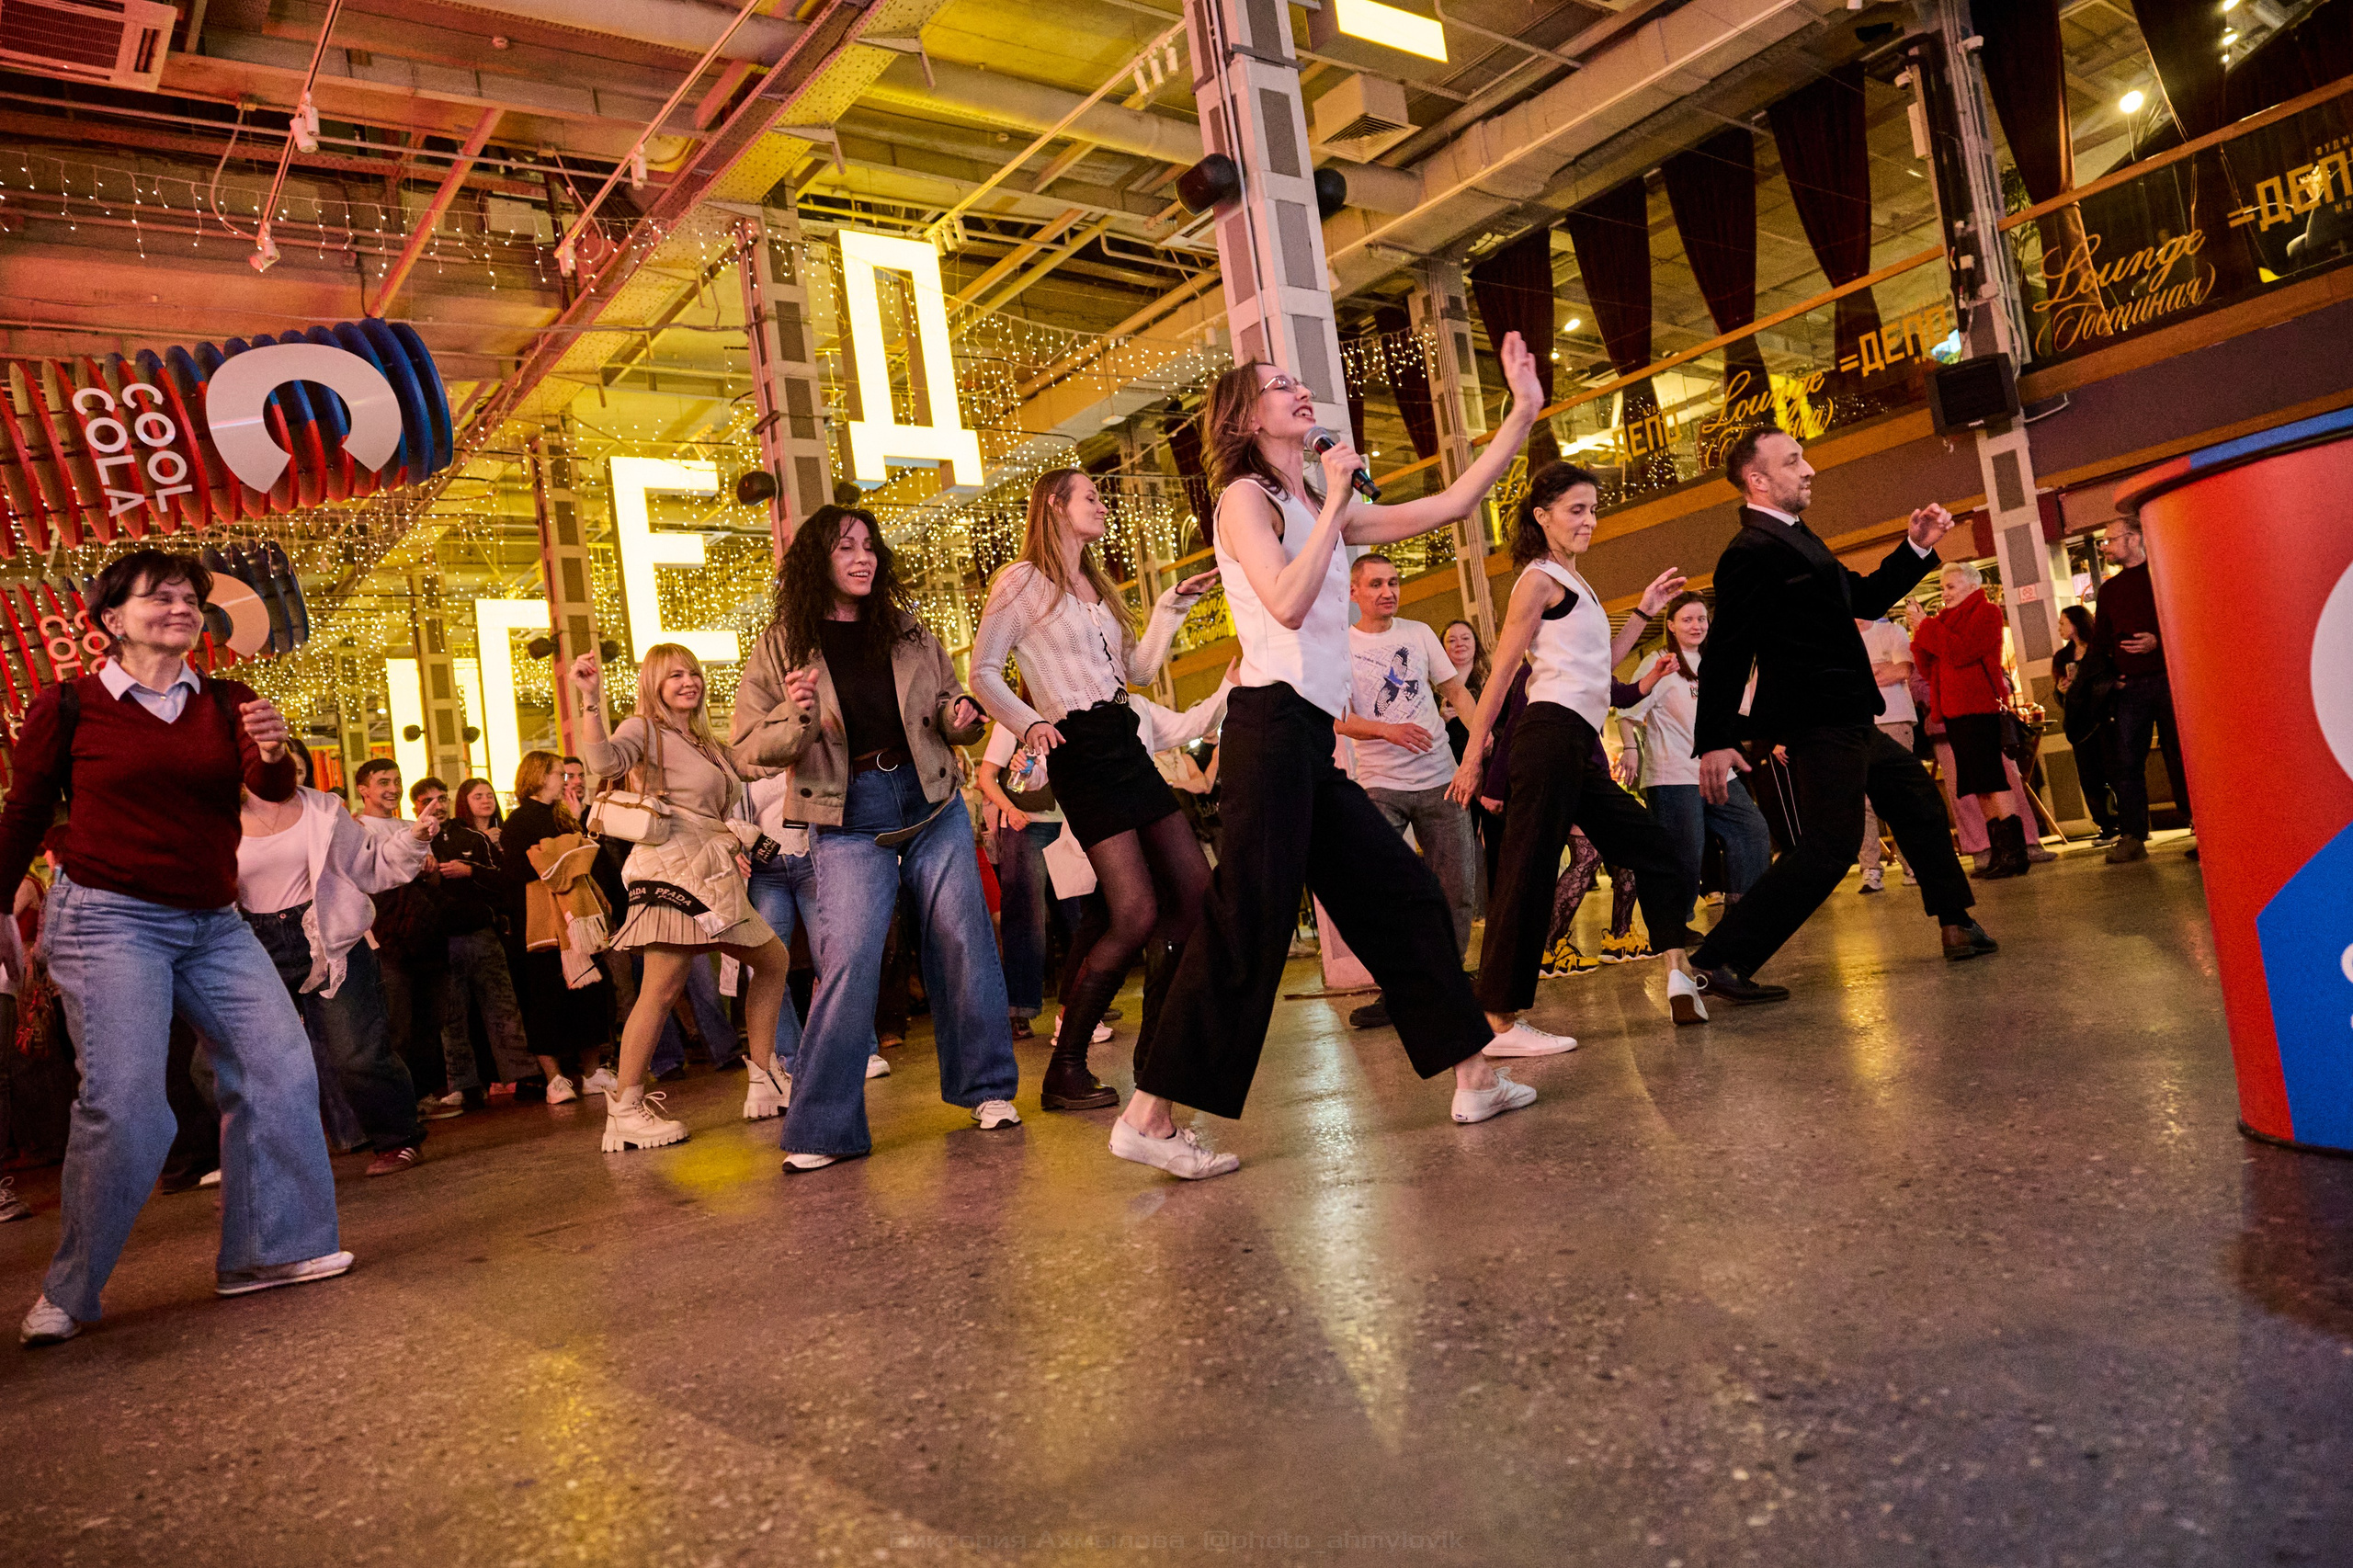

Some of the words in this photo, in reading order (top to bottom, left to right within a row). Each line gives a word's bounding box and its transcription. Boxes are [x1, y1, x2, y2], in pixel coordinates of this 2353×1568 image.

[2032, 229, 2206, 312] Lounge
[1701, 369, 1825, 434] Lounge
[72, 387, 145, 518] COLA
[121, 382, 193, 514] COOL
[39, 615, 82, 682] COL
[654, 887, 692, 907] PRADA
